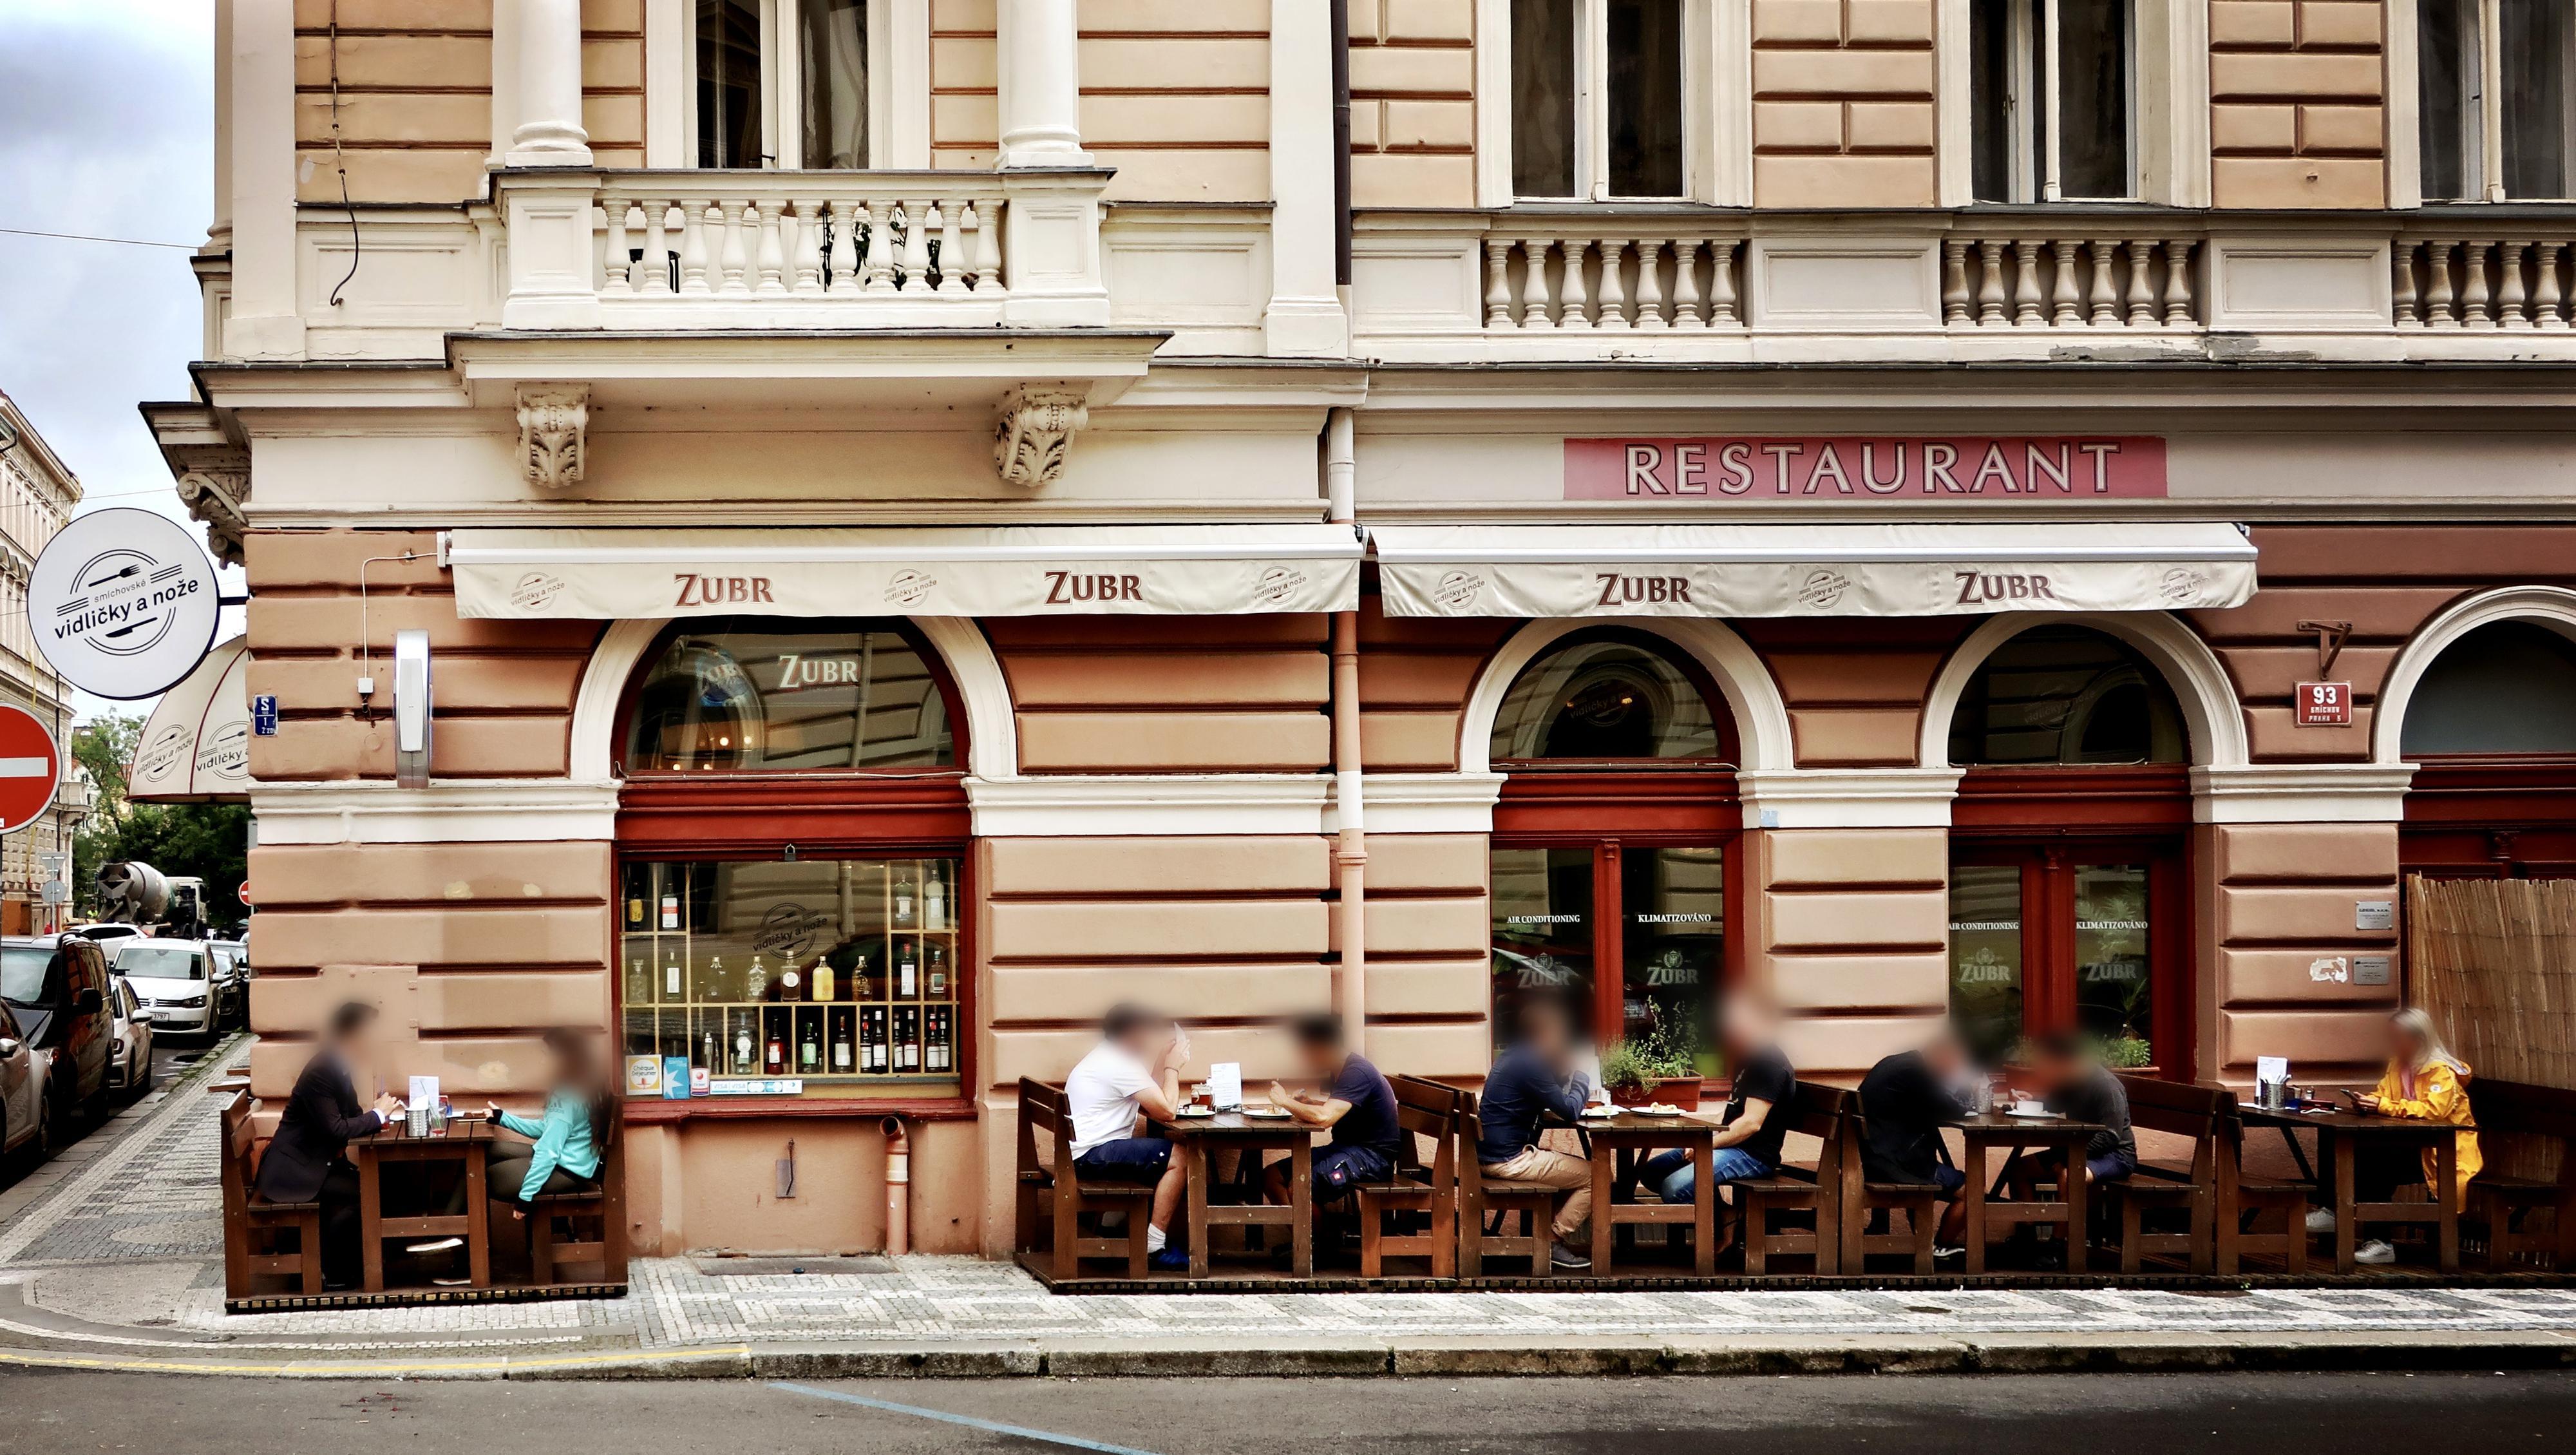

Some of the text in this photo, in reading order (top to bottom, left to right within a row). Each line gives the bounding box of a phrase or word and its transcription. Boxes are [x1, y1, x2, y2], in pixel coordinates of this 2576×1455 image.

[1625, 442, 2121, 495] RESTAURANT
[94, 579, 146, 602] smíchovské
[674, 573, 775, 608] ZUBR
[1044, 570, 1145, 605] ZUBR
[1596, 573, 1695, 607] ZUBR
[1954, 571, 2058, 605] ZUBR
[55, 578, 198, 639] vidličky a nože
[779, 654, 859, 689] ZUBR
[261, 698, 269, 711] S
[2313, 687, 2336, 704] 93
[196, 750, 242, 771] vidličky
[1521, 915, 1580, 923] CONDITIONING
[1638, 913, 1712, 922] KLIMATIZOVÁNO
[1962, 922, 2019, 930] CONDITIONING
[2076, 920, 2148, 929] KLIMATIZOVÁNO
[753, 931, 792, 951] vidličky
[1647, 967, 1700, 986] ZUBR
[1959, 964, 2011, 982] ZUBR
[2086, 962, 2138, 981] ZUBR
